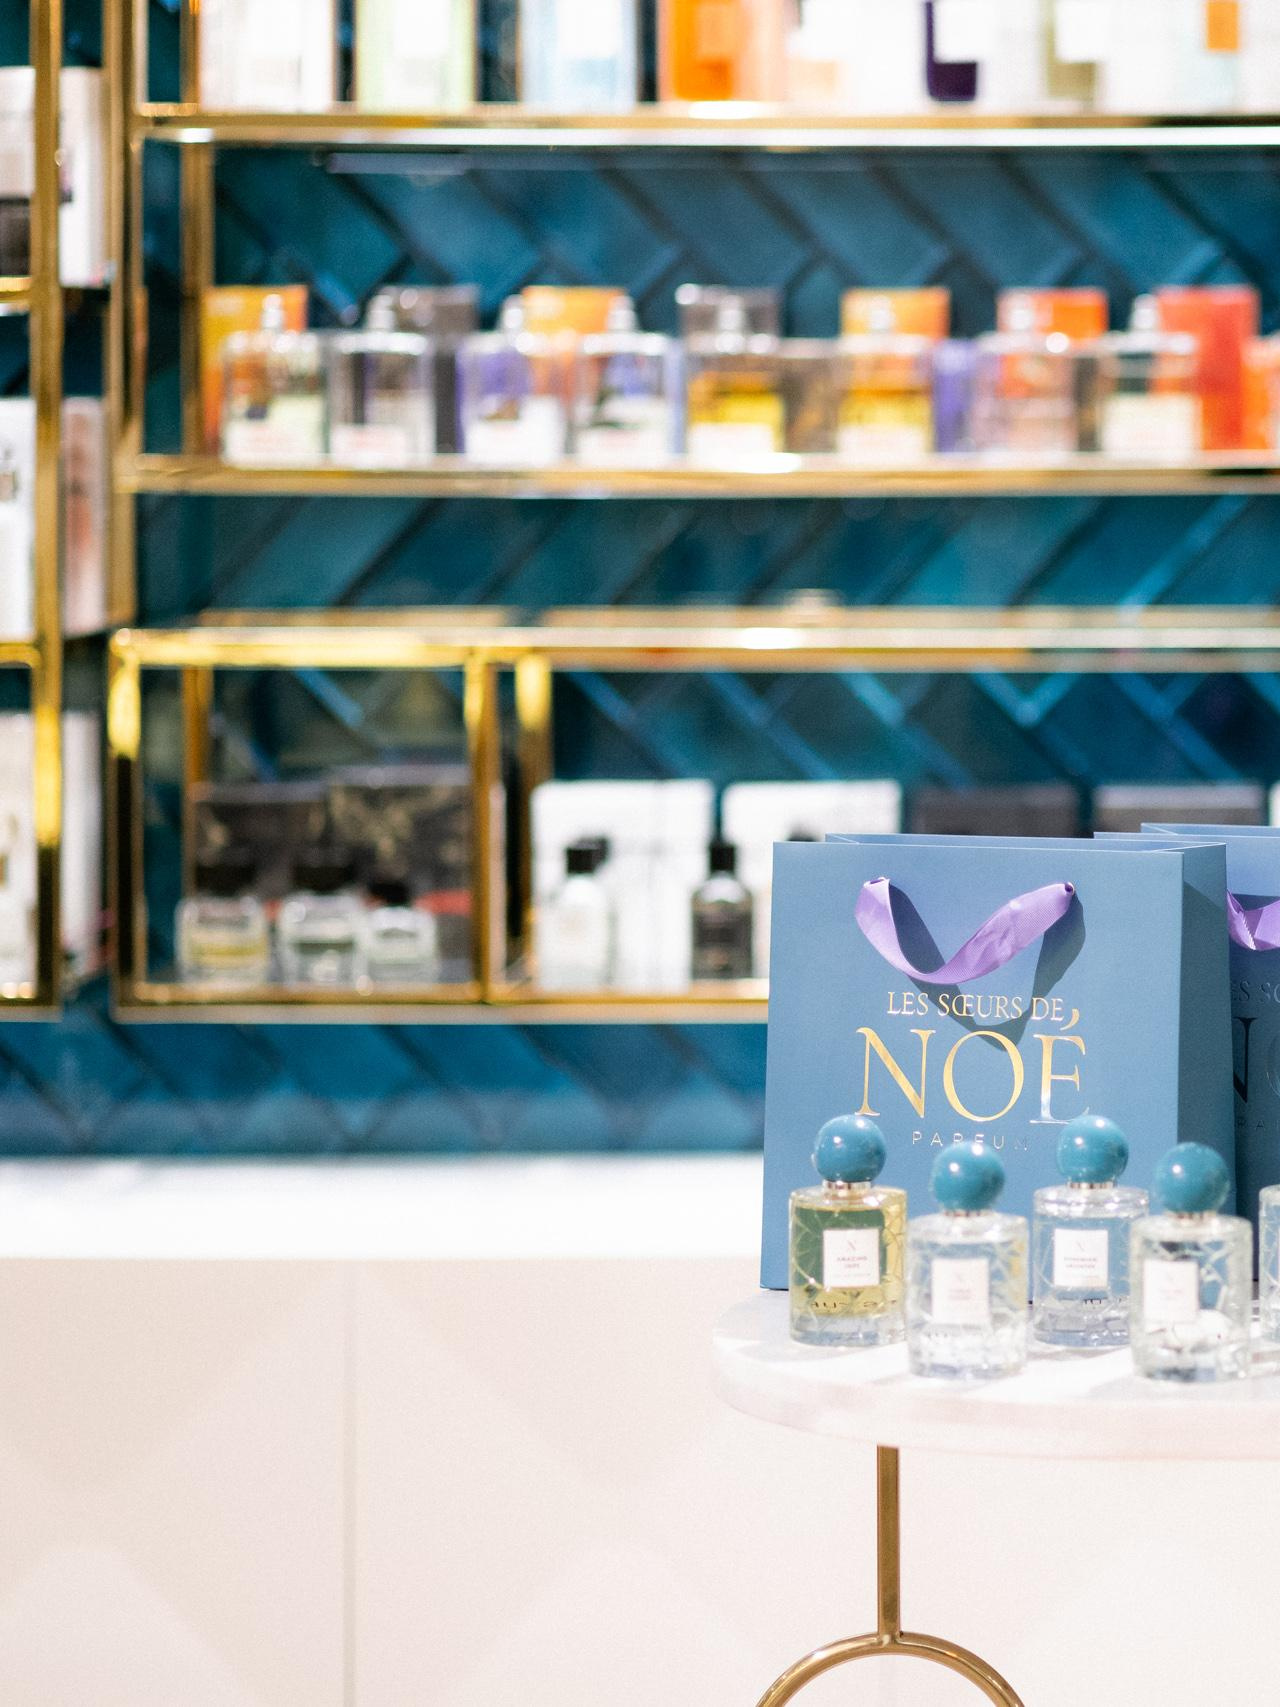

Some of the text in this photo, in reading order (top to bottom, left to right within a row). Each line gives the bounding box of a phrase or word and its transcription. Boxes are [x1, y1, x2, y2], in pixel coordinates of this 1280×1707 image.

[887, 991, 1065, 1021] LES SŒURS DE
[855, 1008, 1090, 1124] NOÉ
